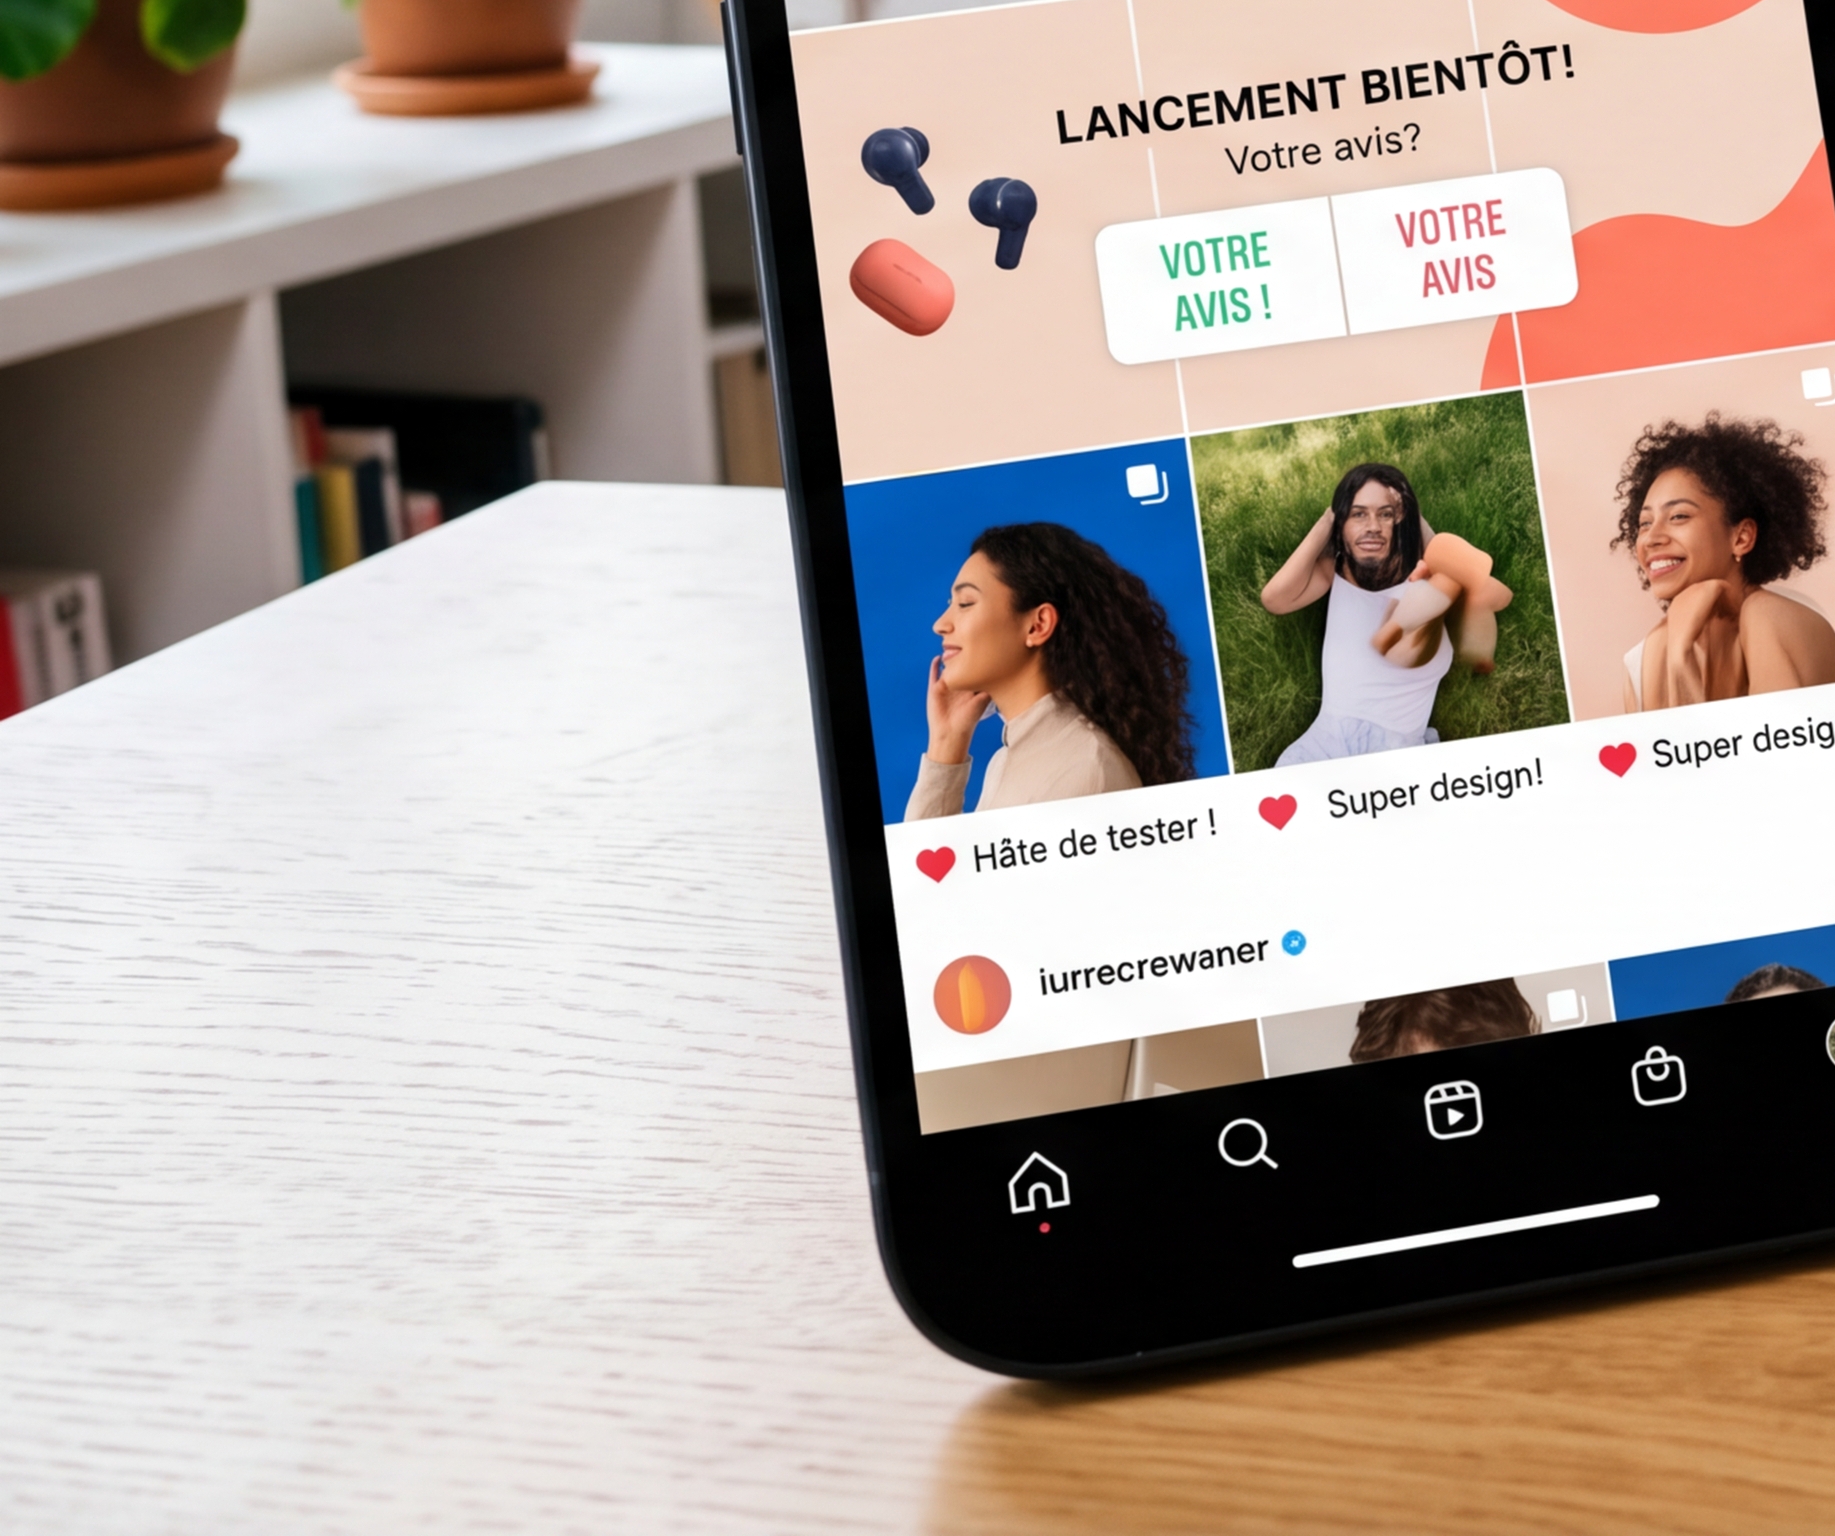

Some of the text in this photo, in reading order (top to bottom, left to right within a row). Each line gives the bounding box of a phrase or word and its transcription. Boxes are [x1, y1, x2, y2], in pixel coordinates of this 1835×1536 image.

[1055, 39, 1576, 145] LANCEMENT BIENTÔT!
[1224, 122, 1422, 176] Votre avis?
[1395, 199, 1507, 248] VOTRE
[1159, 231, 1272, 280] VOTRE
[1422, 254, 1497, 298] AVIS
[1174, 287, 1252, 332] AVIS
[1651, 728, 1743, 771] Super
[1327, 755, 1544, 821] Super design!
[1059, 829, 1097, 859] de
[1107, 818, 1197, 851] tester
[1039, 939, 1269, 996] iurrecrewaner
